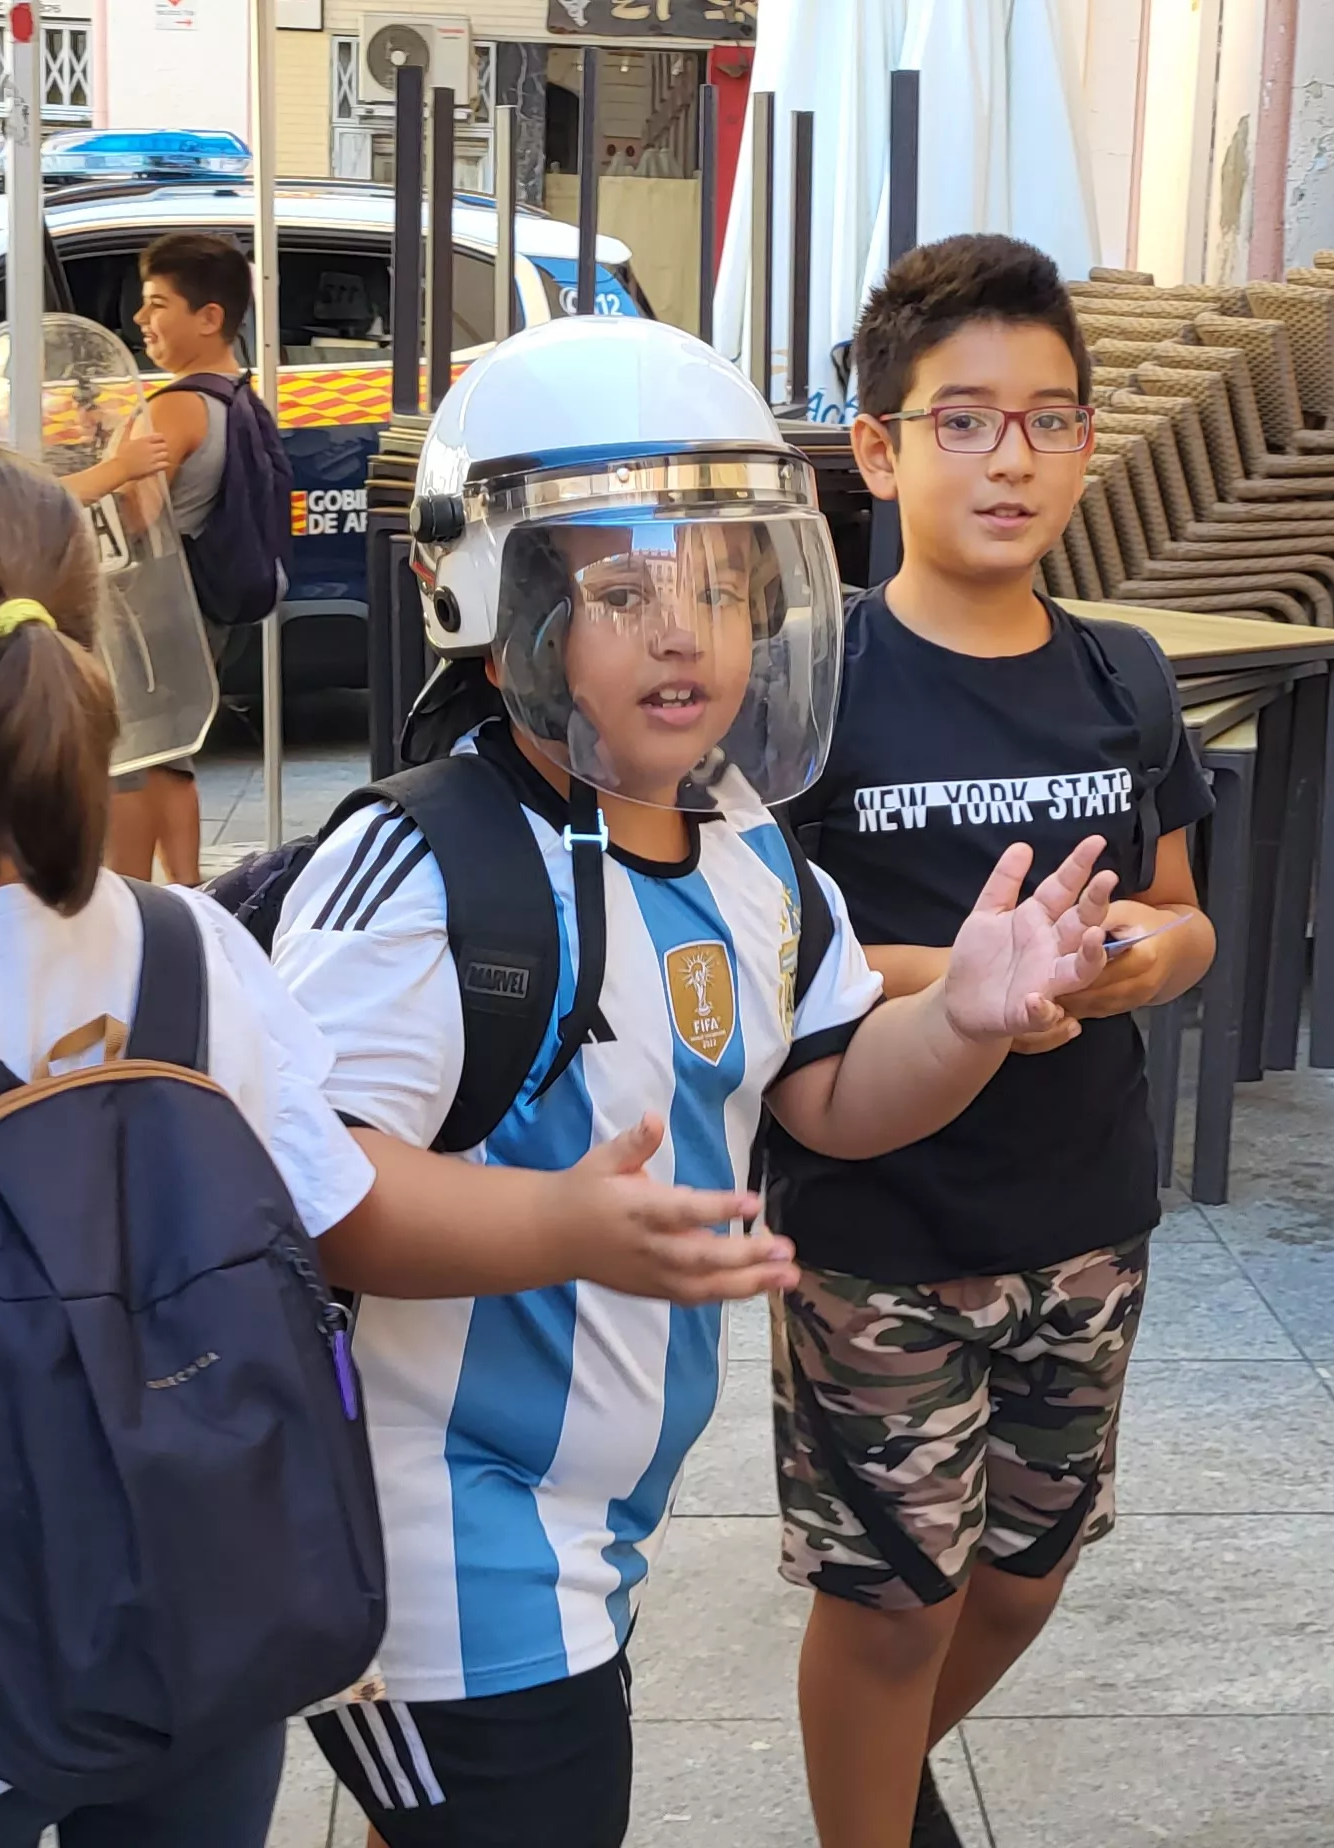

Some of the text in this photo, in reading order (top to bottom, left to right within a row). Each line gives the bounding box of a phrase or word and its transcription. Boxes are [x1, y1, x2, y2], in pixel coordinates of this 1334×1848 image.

[308, 513, 338, 534] DE
[856, 770, 1132, 832] NEW YORK STATE
[693, 1017, 719, 1035] FIFA
